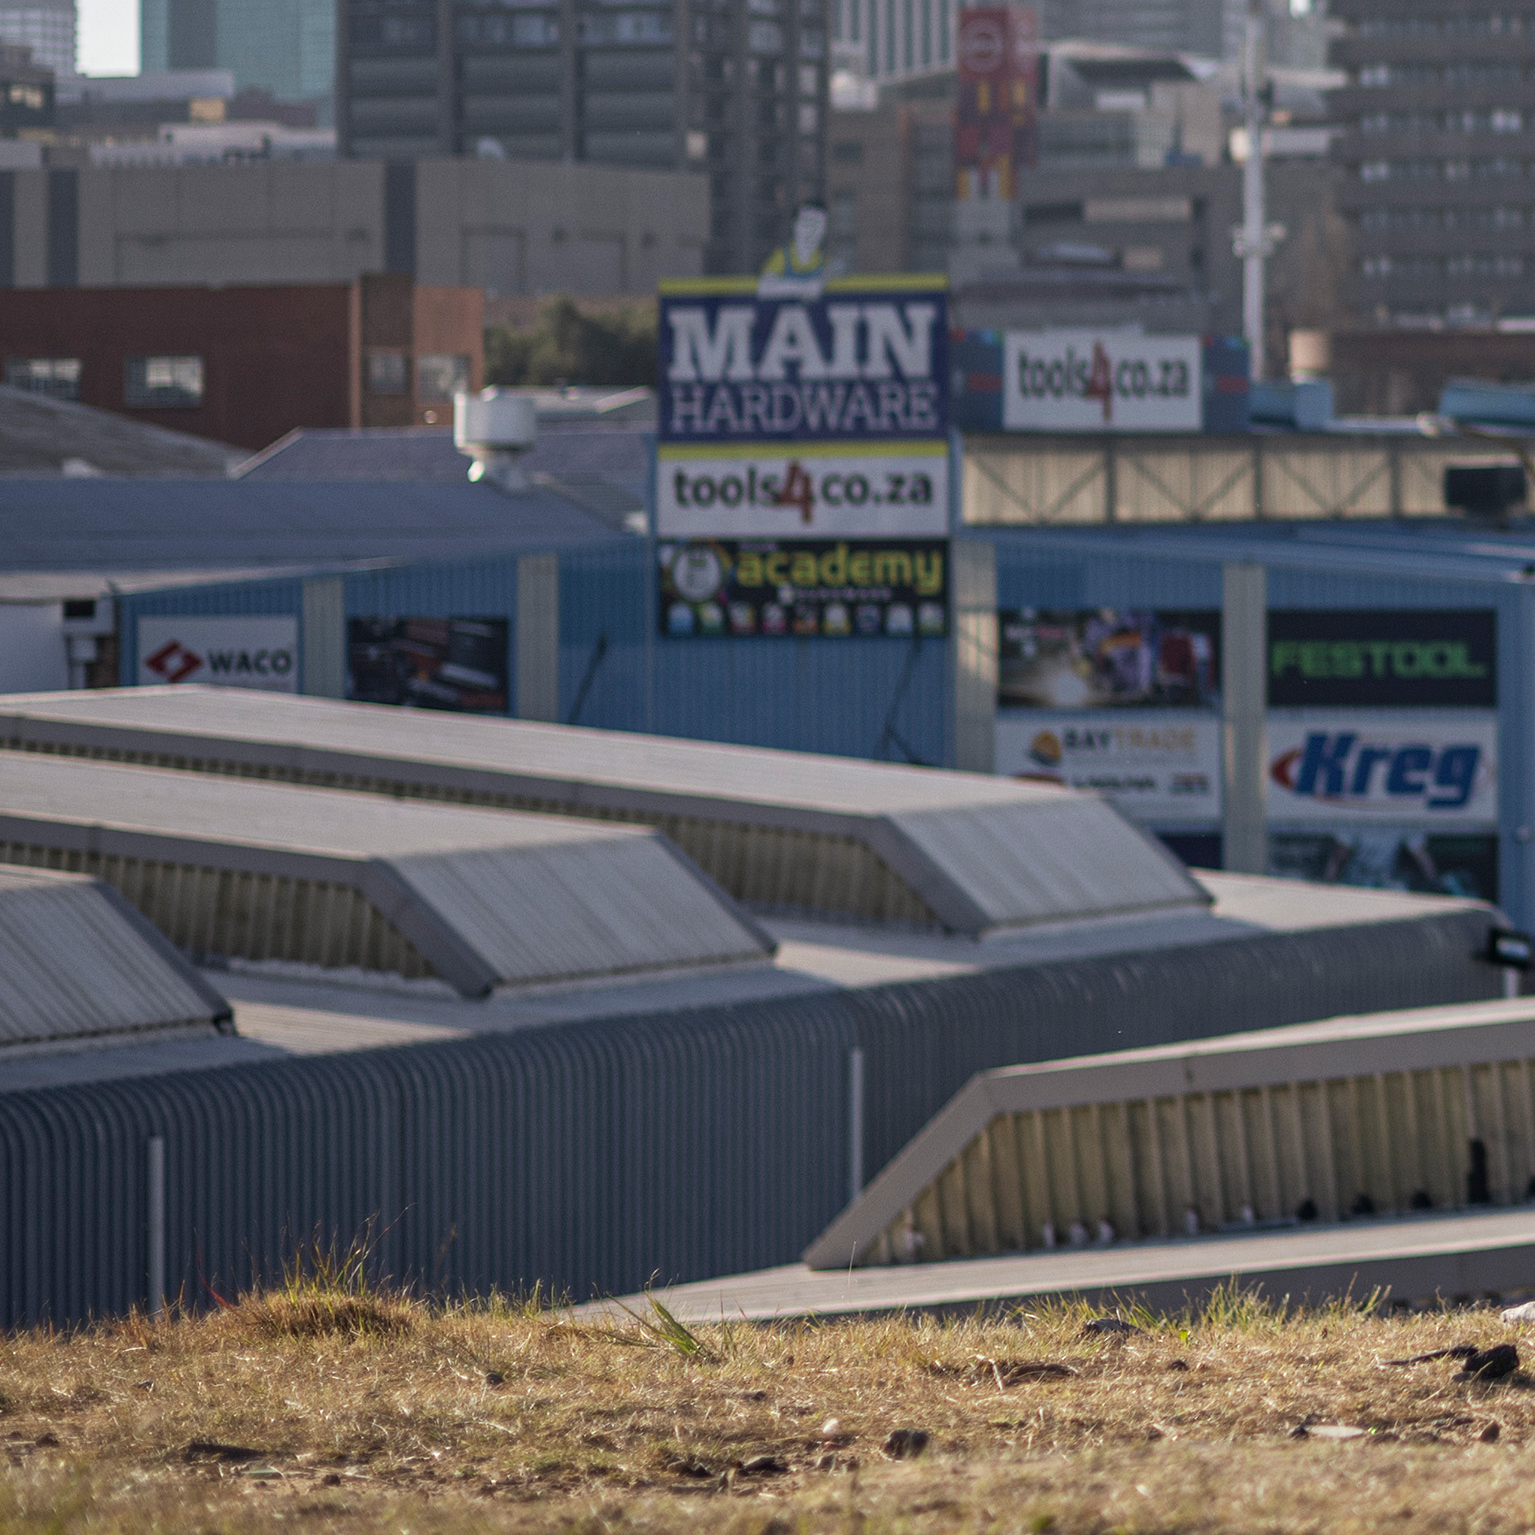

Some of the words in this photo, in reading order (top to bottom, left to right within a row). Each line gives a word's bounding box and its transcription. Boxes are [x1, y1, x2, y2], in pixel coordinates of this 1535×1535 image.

[668, 303, 936, 381] MAIN
[671, 382, 938, 433] HARDWARE
[736, 544, 942, 596] academy
[207, 648, 293, 674] WACO
[1271, 640, 1487, 678] FESTOOL
[1295, 731, 1481, 810] Kreg
